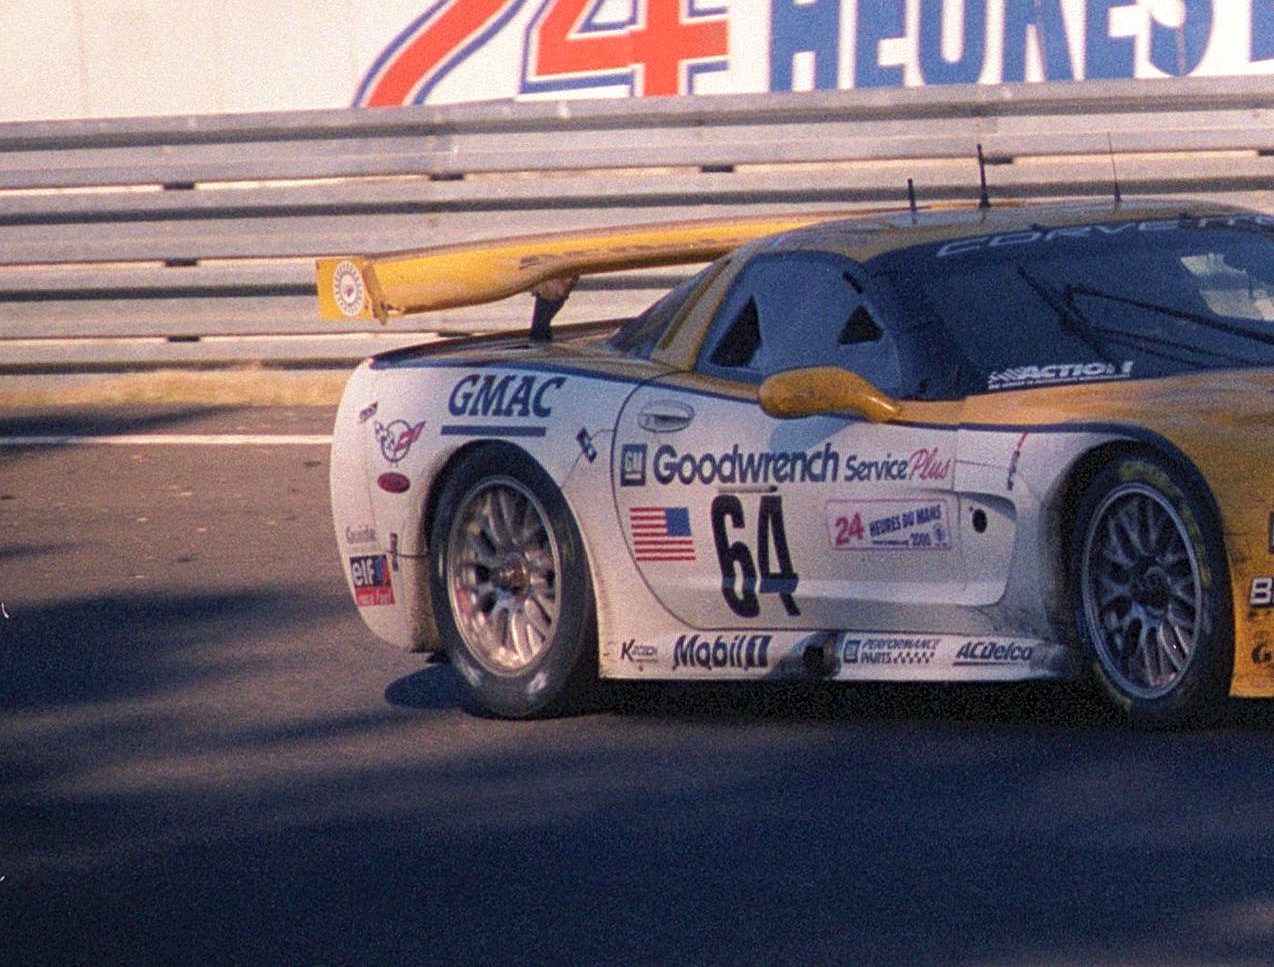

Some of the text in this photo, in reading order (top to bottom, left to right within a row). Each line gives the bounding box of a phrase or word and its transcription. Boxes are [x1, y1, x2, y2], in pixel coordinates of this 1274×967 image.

[448, 374, 567, 418] GMAC
[653, 442, 952, 485] Goodwrench Service Plus
[835, 512, 864, 546] 24
[868, 515, 901, 537] HEURES
[352, 557, 375, 586] elf
[711, 494, 801, 618] 64
[672, 634, 746, 670] Mobil
[860, 651, 891, 665] PARTS
[862, 638, 940, 650] PERFORMANCE
[956, 641, 1033, 662] ACDelco
